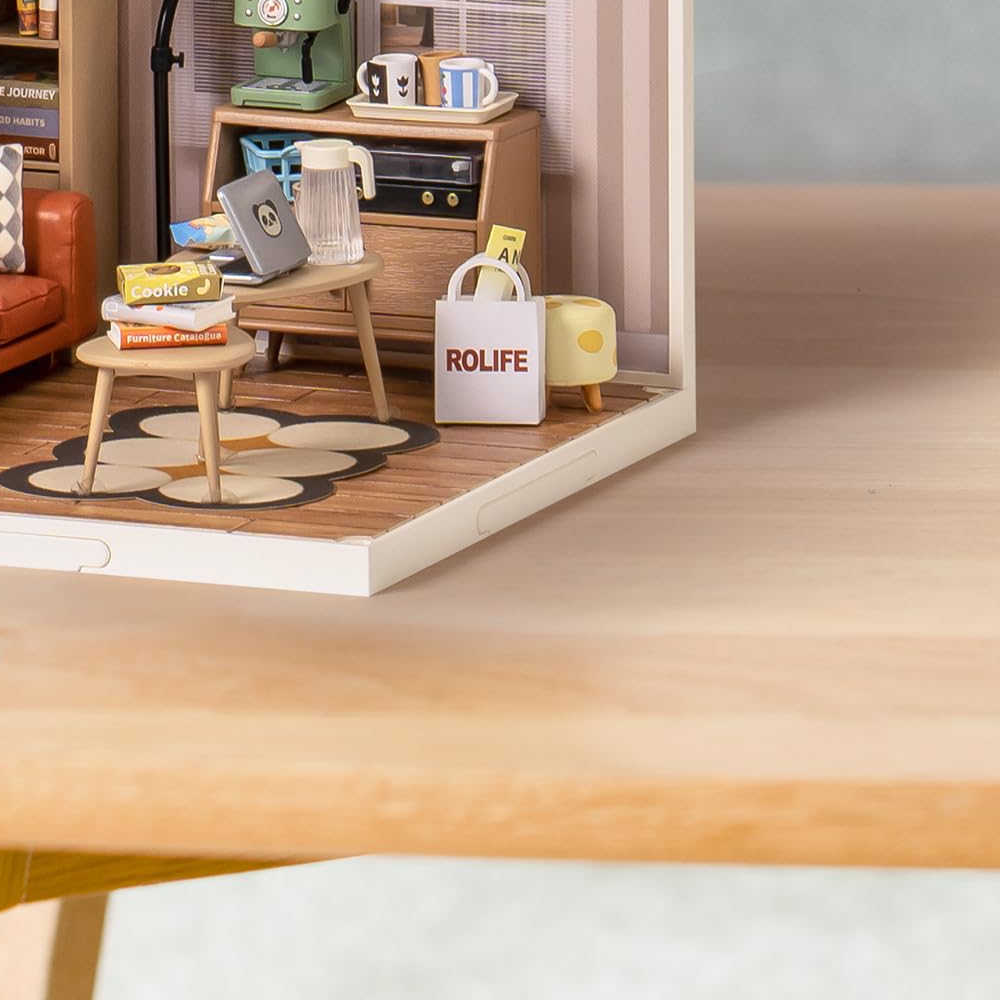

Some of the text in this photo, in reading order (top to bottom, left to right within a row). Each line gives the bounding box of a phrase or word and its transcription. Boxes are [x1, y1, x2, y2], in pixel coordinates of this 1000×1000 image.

[7, 87, 56, 101] JOURNEY
[13, 117, 46, 128] HABITS
[131, 284, 188, 298] Cookie
[127, 331, 222, 344] Furniture Catalogue
[446, 349, 528, 372] ROLIFE
